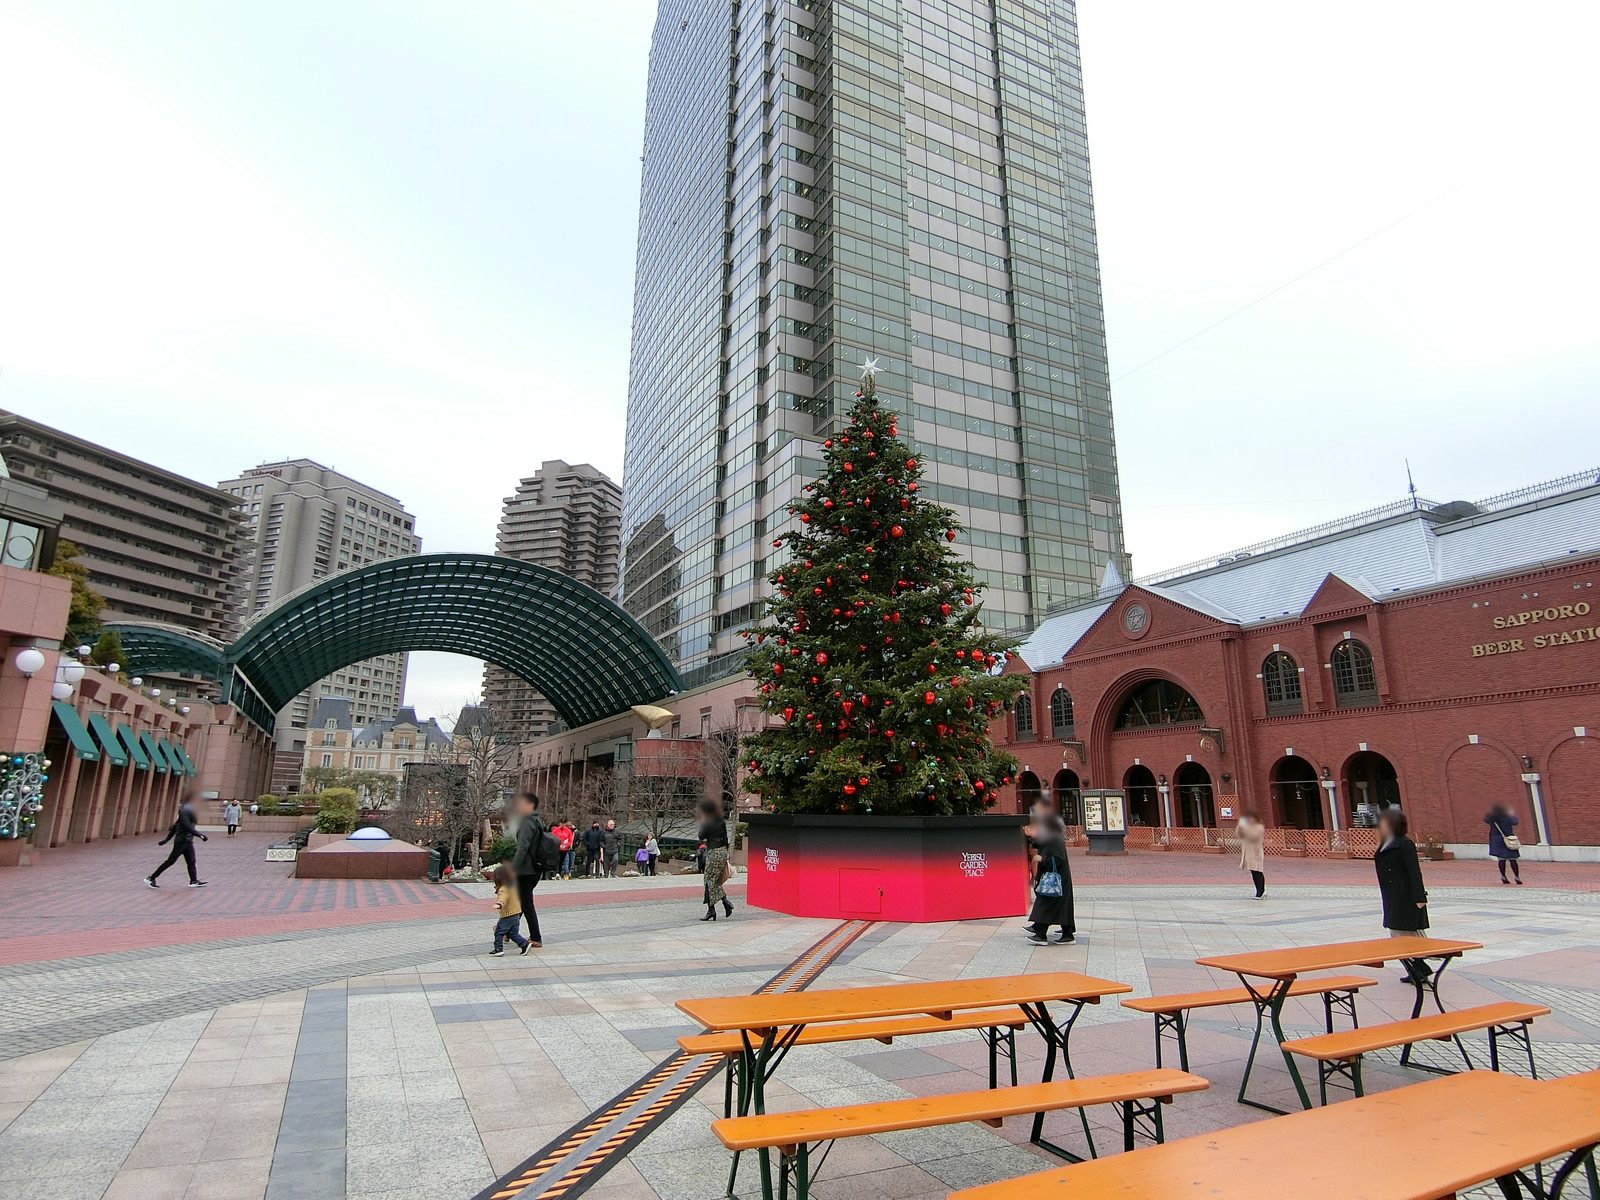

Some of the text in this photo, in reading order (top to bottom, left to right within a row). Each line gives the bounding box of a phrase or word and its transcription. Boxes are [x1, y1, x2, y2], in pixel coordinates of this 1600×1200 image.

[1493, 602, 1591, 629] SAPPORO
[1471, 639, 1526, 657] BEER
[962, 852, 986, 861] YEBISU
[959, 860, 988, 869] GARDEN
[964, 868, 985, 877] PLACE
